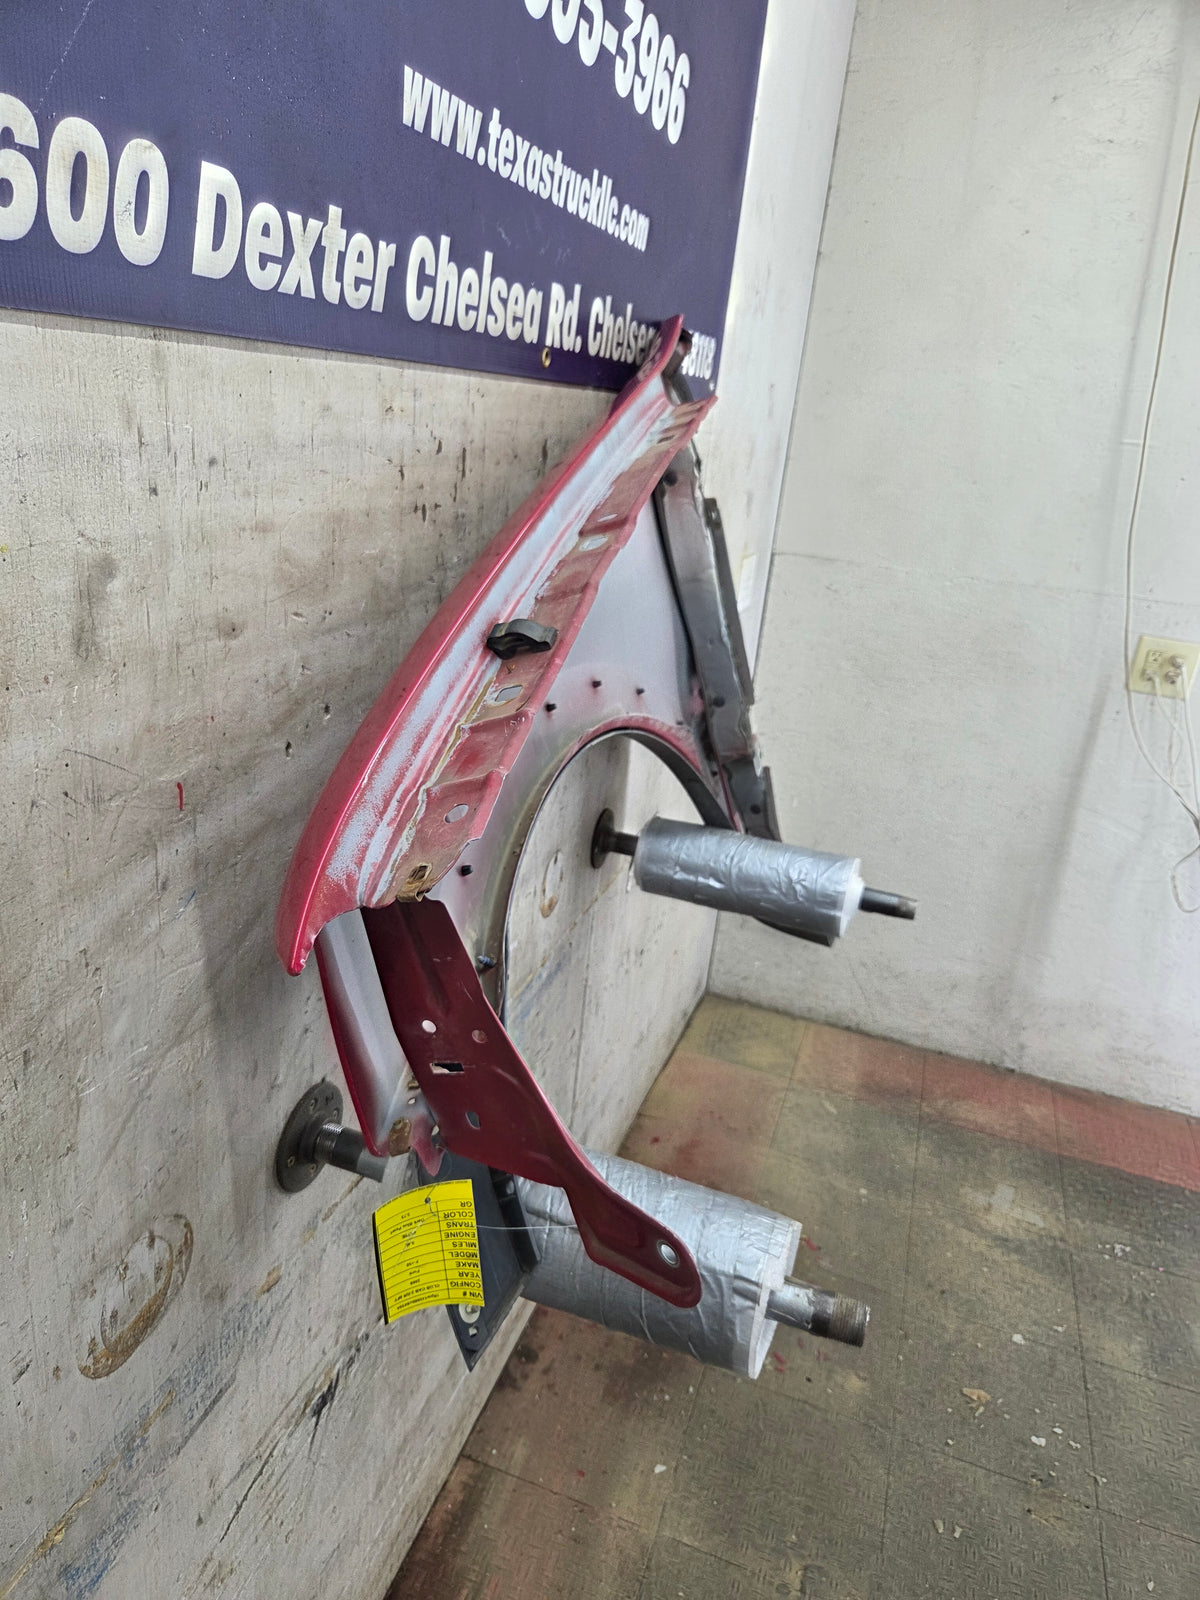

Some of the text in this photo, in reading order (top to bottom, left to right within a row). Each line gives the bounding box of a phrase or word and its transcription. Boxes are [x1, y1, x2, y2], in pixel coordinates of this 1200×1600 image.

[402, 64, 651, 253] www.texastruckllc.com
[191, 160, 397, 313] Dexter
[405, 234, 544, 344] Chelsea
[545, 281, 583, 354] Rd.
[460, 1200, 473, 1208] GR
[443, 1211, 474, 1219] COLOR
[445, 1221, 476, 1229] TRANS
[444, 1231, 476, 1239] ENGINE
[448, 1251, 478, 1259] MODEL
[455, 1260, 480, 1269] MAKE
[458, 1270, 481, 1279] YEAR
[450, 1280, 482, 1289] CONFIG
[469, 1291, 483, 1299] VIN
